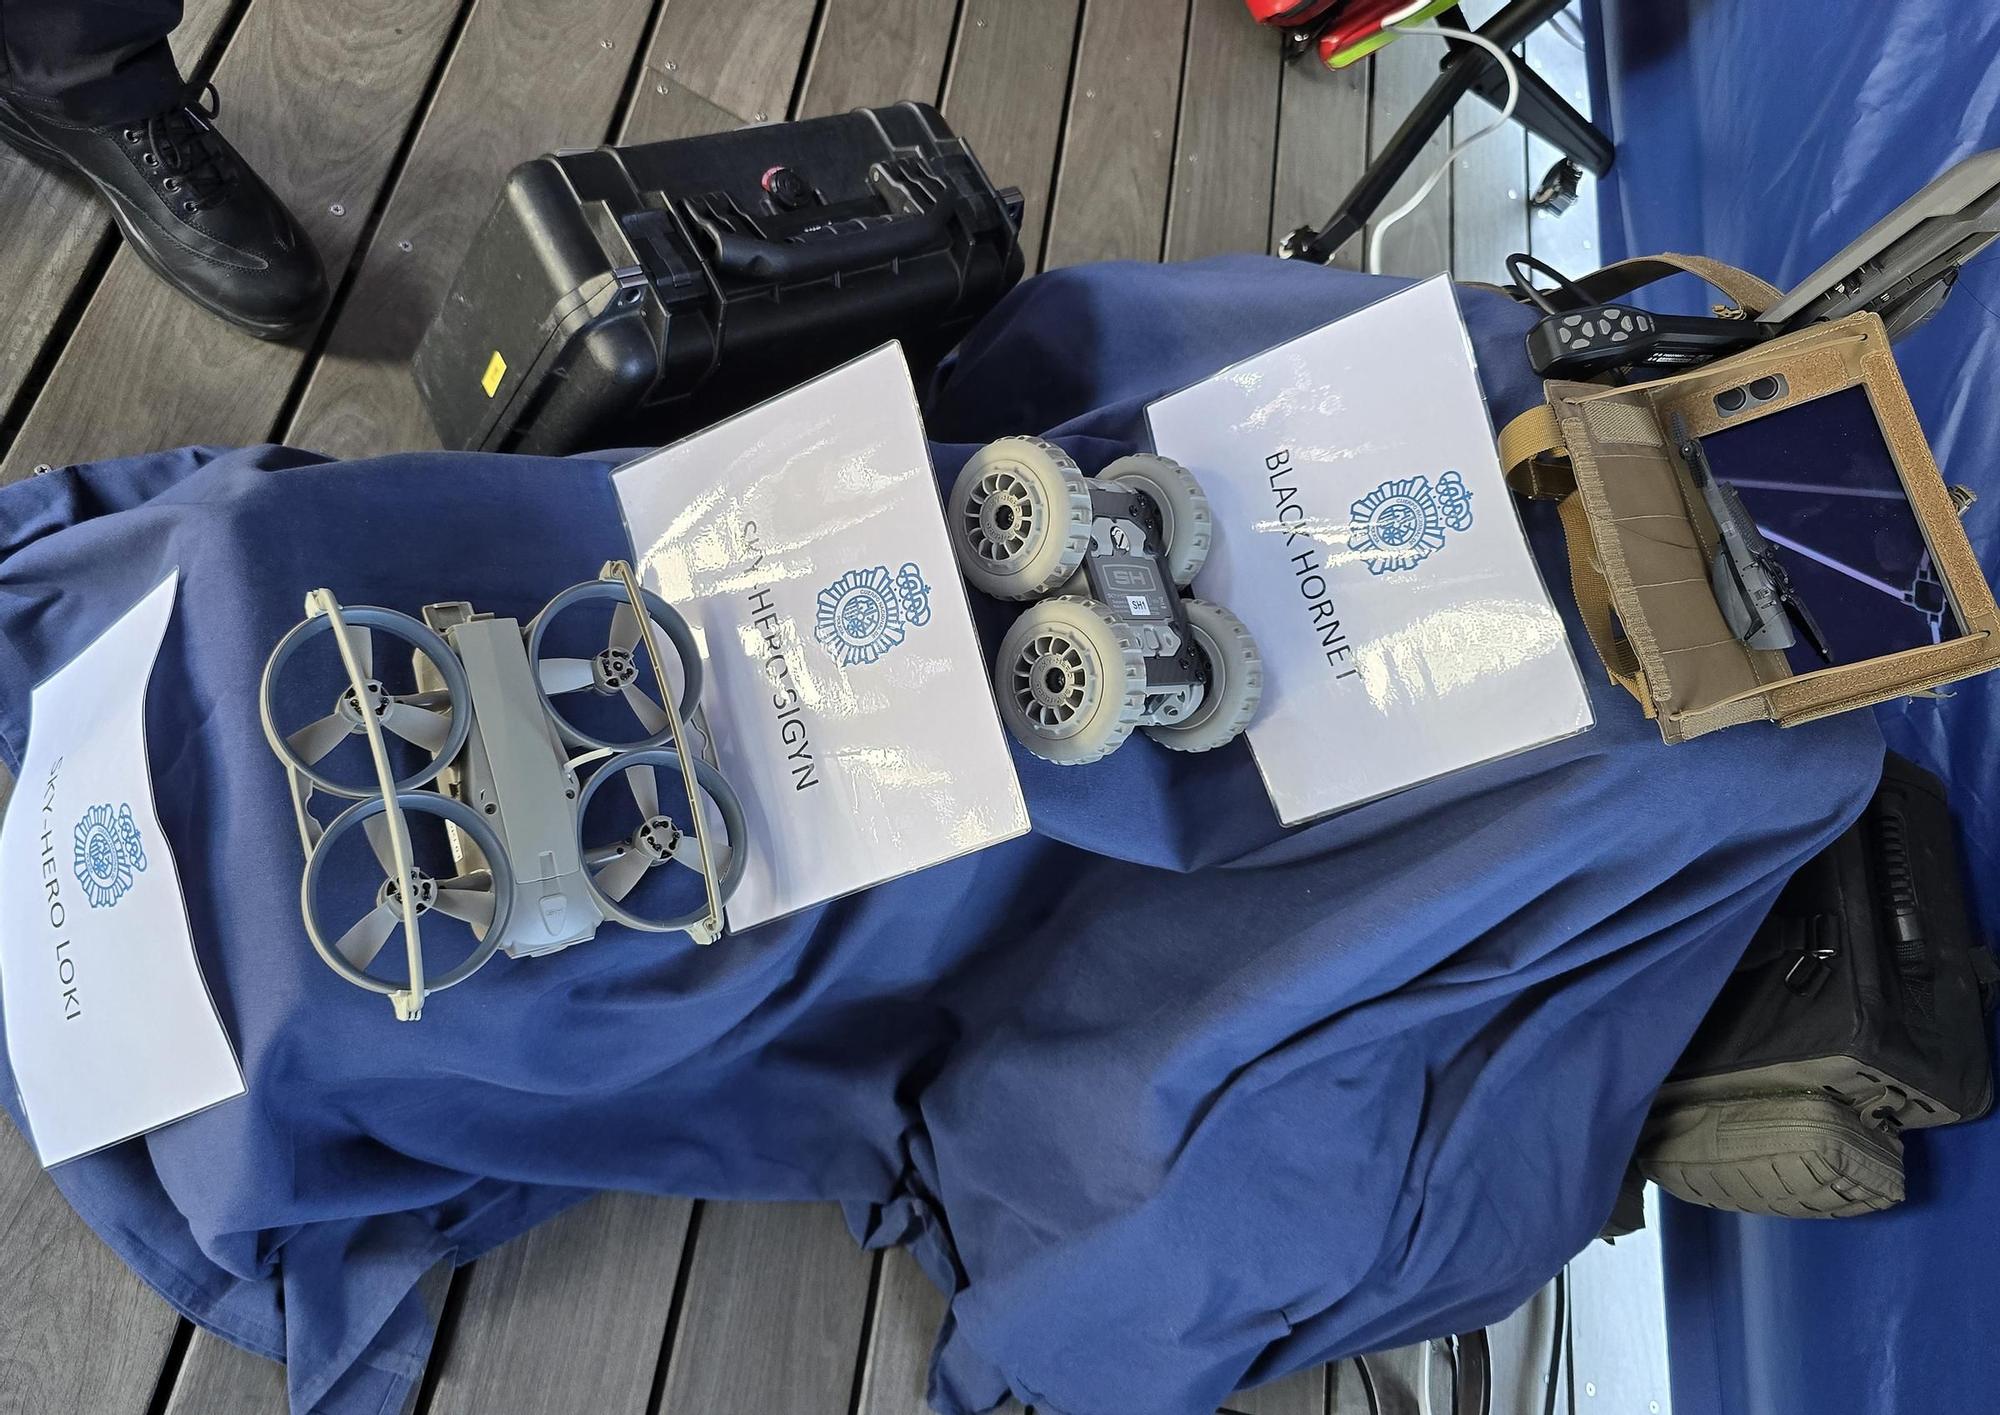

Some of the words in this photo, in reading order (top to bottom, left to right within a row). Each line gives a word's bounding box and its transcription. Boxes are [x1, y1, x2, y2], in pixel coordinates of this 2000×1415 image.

[1131, 600, 1147, 610] SH1
[1265, 450, 1309, 547] BLACK
[1291, 549, 1362, 680] HORNET
[773, 688, 819, 791] SIGYN
[41, 756, 64, 928] SKY-HERO
[56, 940, 81, 1020] LOKI
